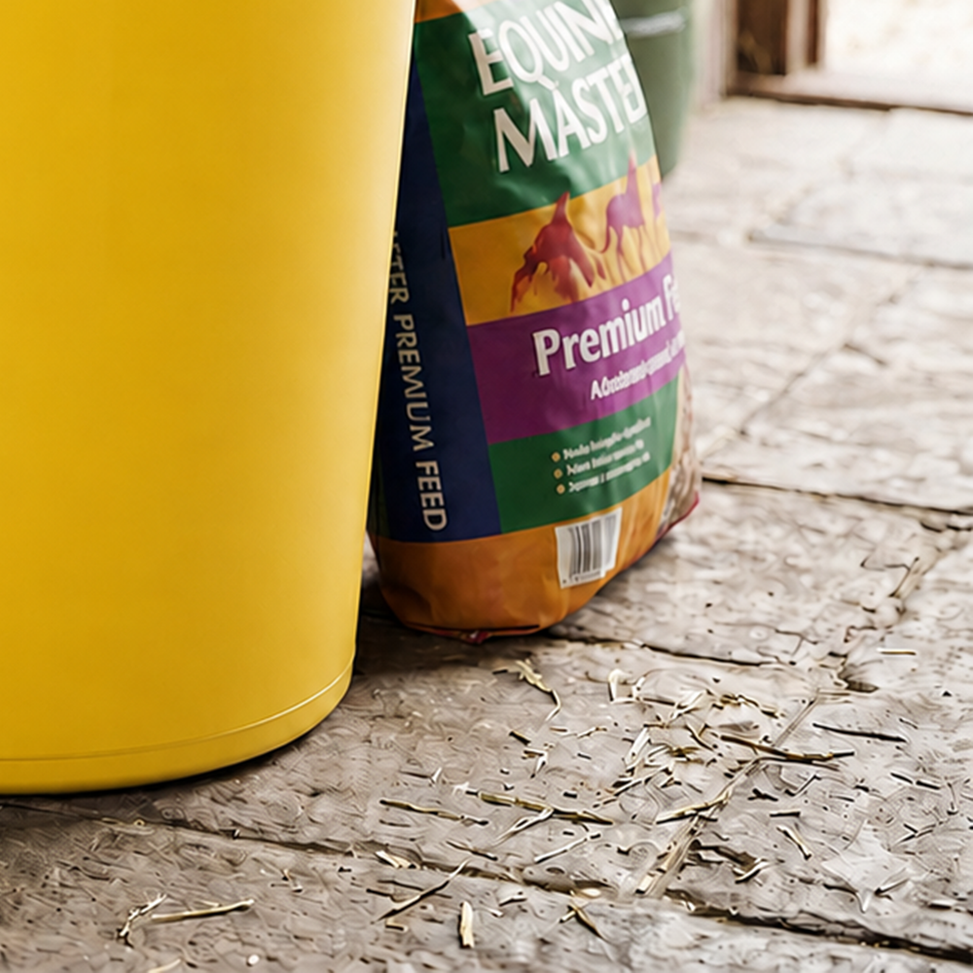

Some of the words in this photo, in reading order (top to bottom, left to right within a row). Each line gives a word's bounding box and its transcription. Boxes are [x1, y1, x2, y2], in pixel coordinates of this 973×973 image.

[493, 52, 648, 173] MASTE
[532, 298, 667, 377] Premium
[393, 314, 435, 451] PREMIUM
[416, 460, 448, 532] FEED
